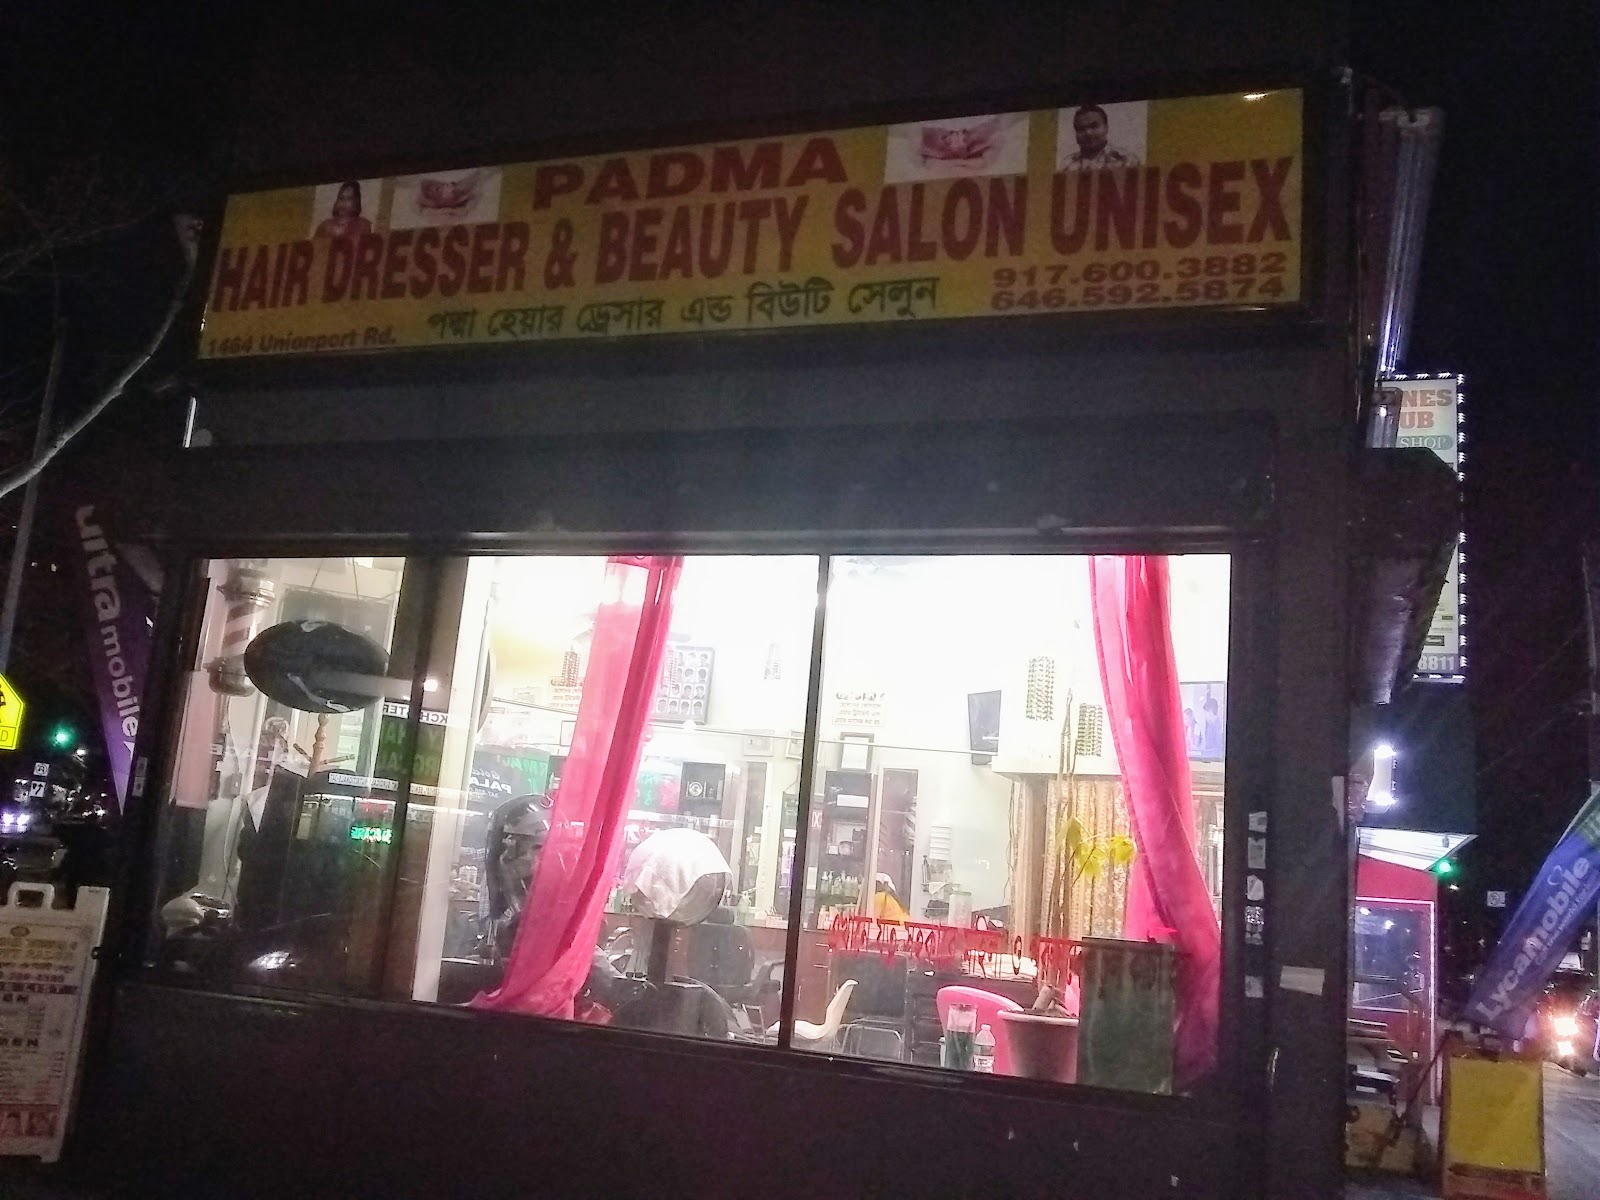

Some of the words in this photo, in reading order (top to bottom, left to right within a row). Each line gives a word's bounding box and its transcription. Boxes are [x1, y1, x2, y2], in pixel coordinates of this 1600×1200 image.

[533, 137, 848, 210] PADMA
[213, 241, 313, 311] HAIR
[321, 223, 530, 301] DRESSER
[544, 217, 580, 290] &
[594, 195, 809, 285] BEAUTY
[831, 175, 1028, 271] SALON
[1049, 157, 1295, 257] UNISEX
[992, 251, 1288, 289] 917.600.3882
[259, 330, 358, 354] Unionport
[1475, 856, 1591, 1022] Lycamobile
